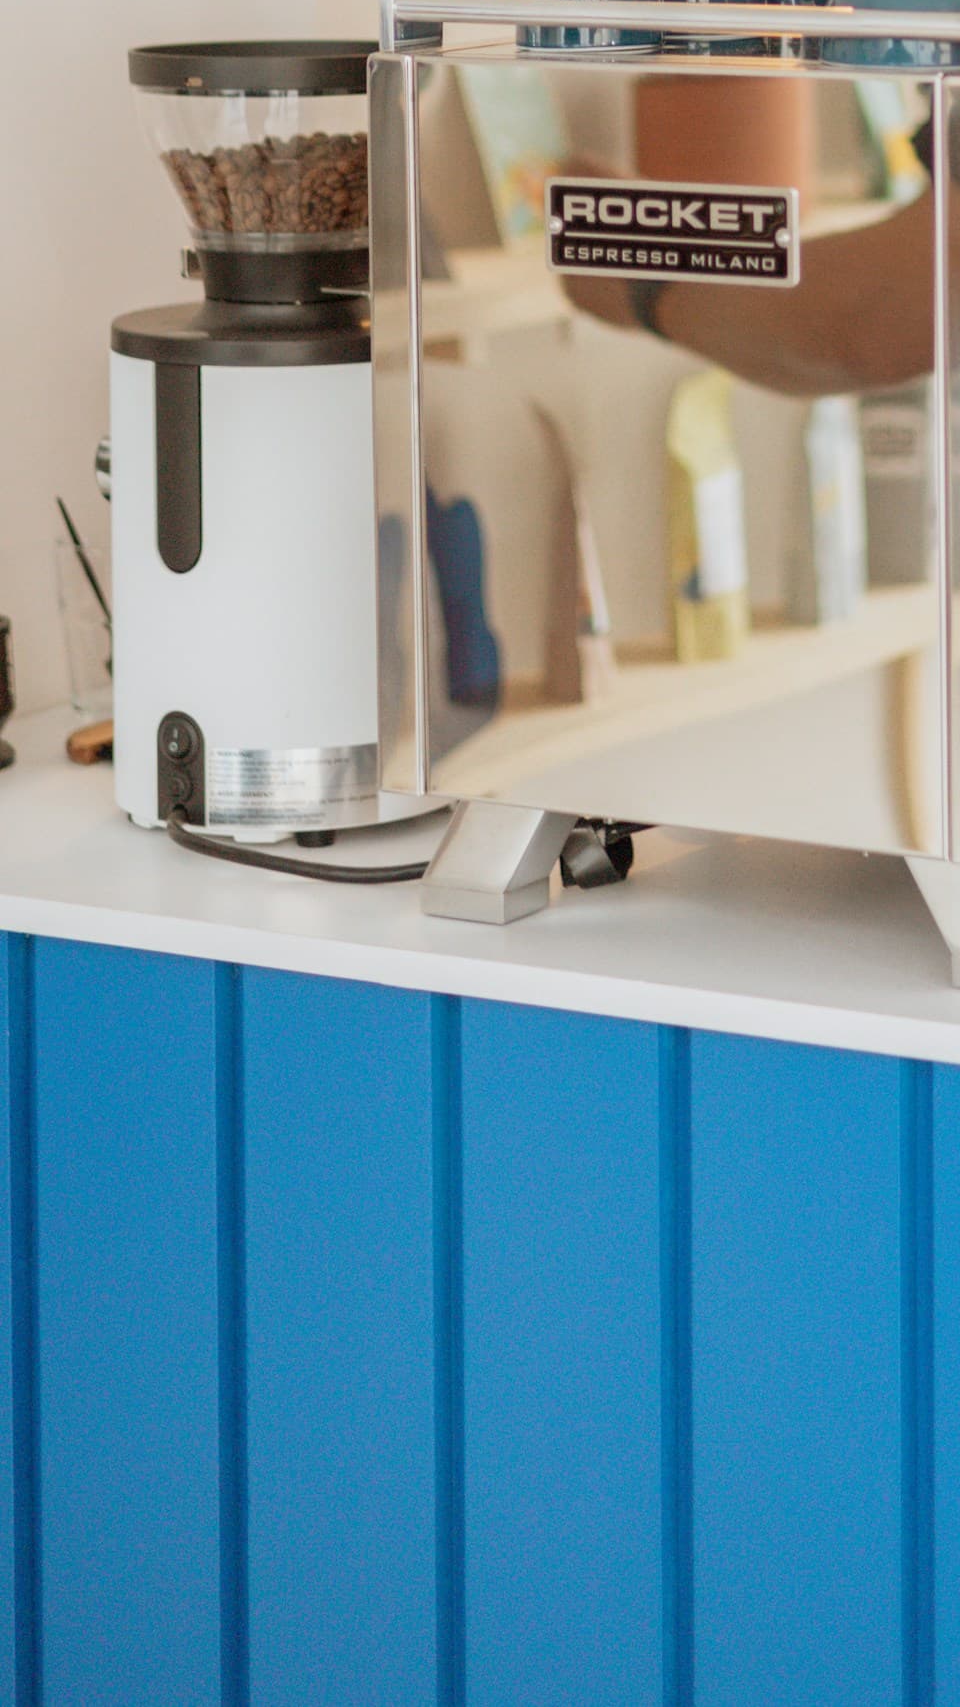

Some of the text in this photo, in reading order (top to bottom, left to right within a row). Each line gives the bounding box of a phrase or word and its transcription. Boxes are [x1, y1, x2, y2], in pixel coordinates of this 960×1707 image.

[562, 194, 775, 234] ROCKET
[563, 245, 776, 272] ESPRESSO MILANO
